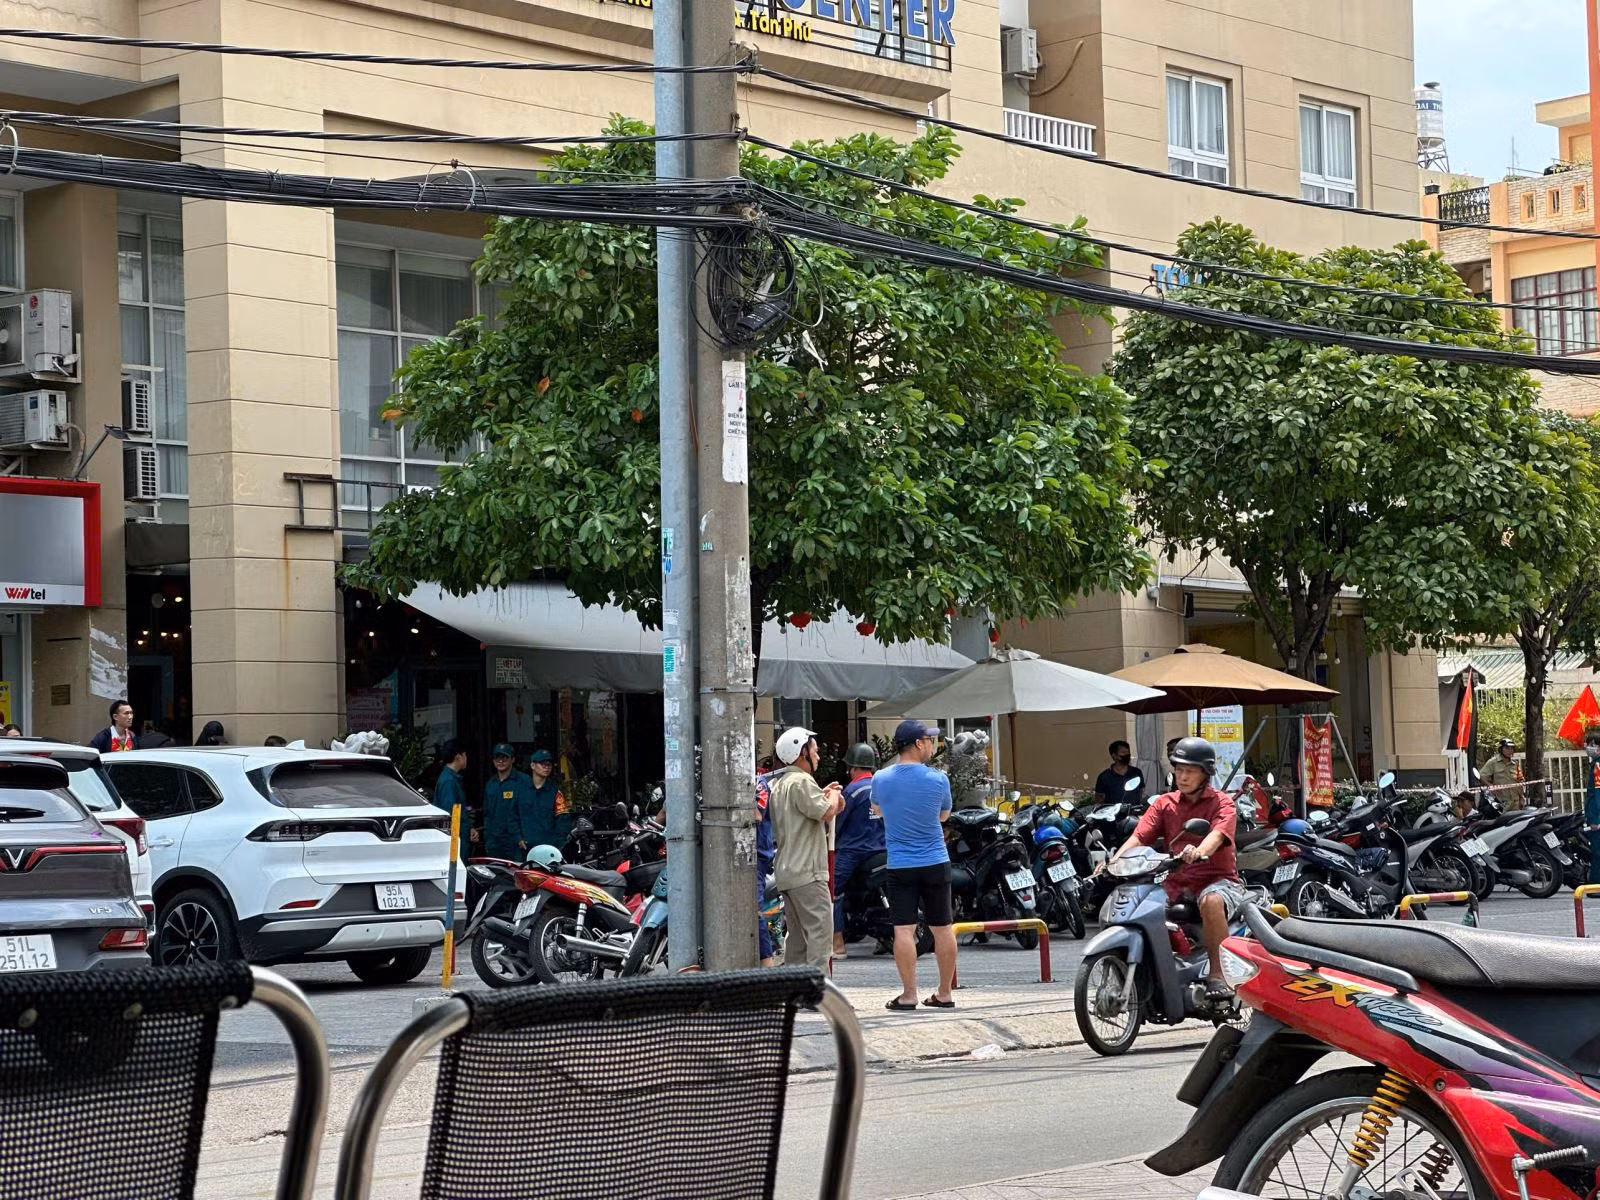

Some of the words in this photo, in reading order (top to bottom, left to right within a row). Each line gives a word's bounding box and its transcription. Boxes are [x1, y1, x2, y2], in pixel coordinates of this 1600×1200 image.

[29, 310, 38, 318] LG
[386, 884, 403, 896] 95A
[7, 937, 35, 952] 51L
[0, 953, 50, 970] 251.12
